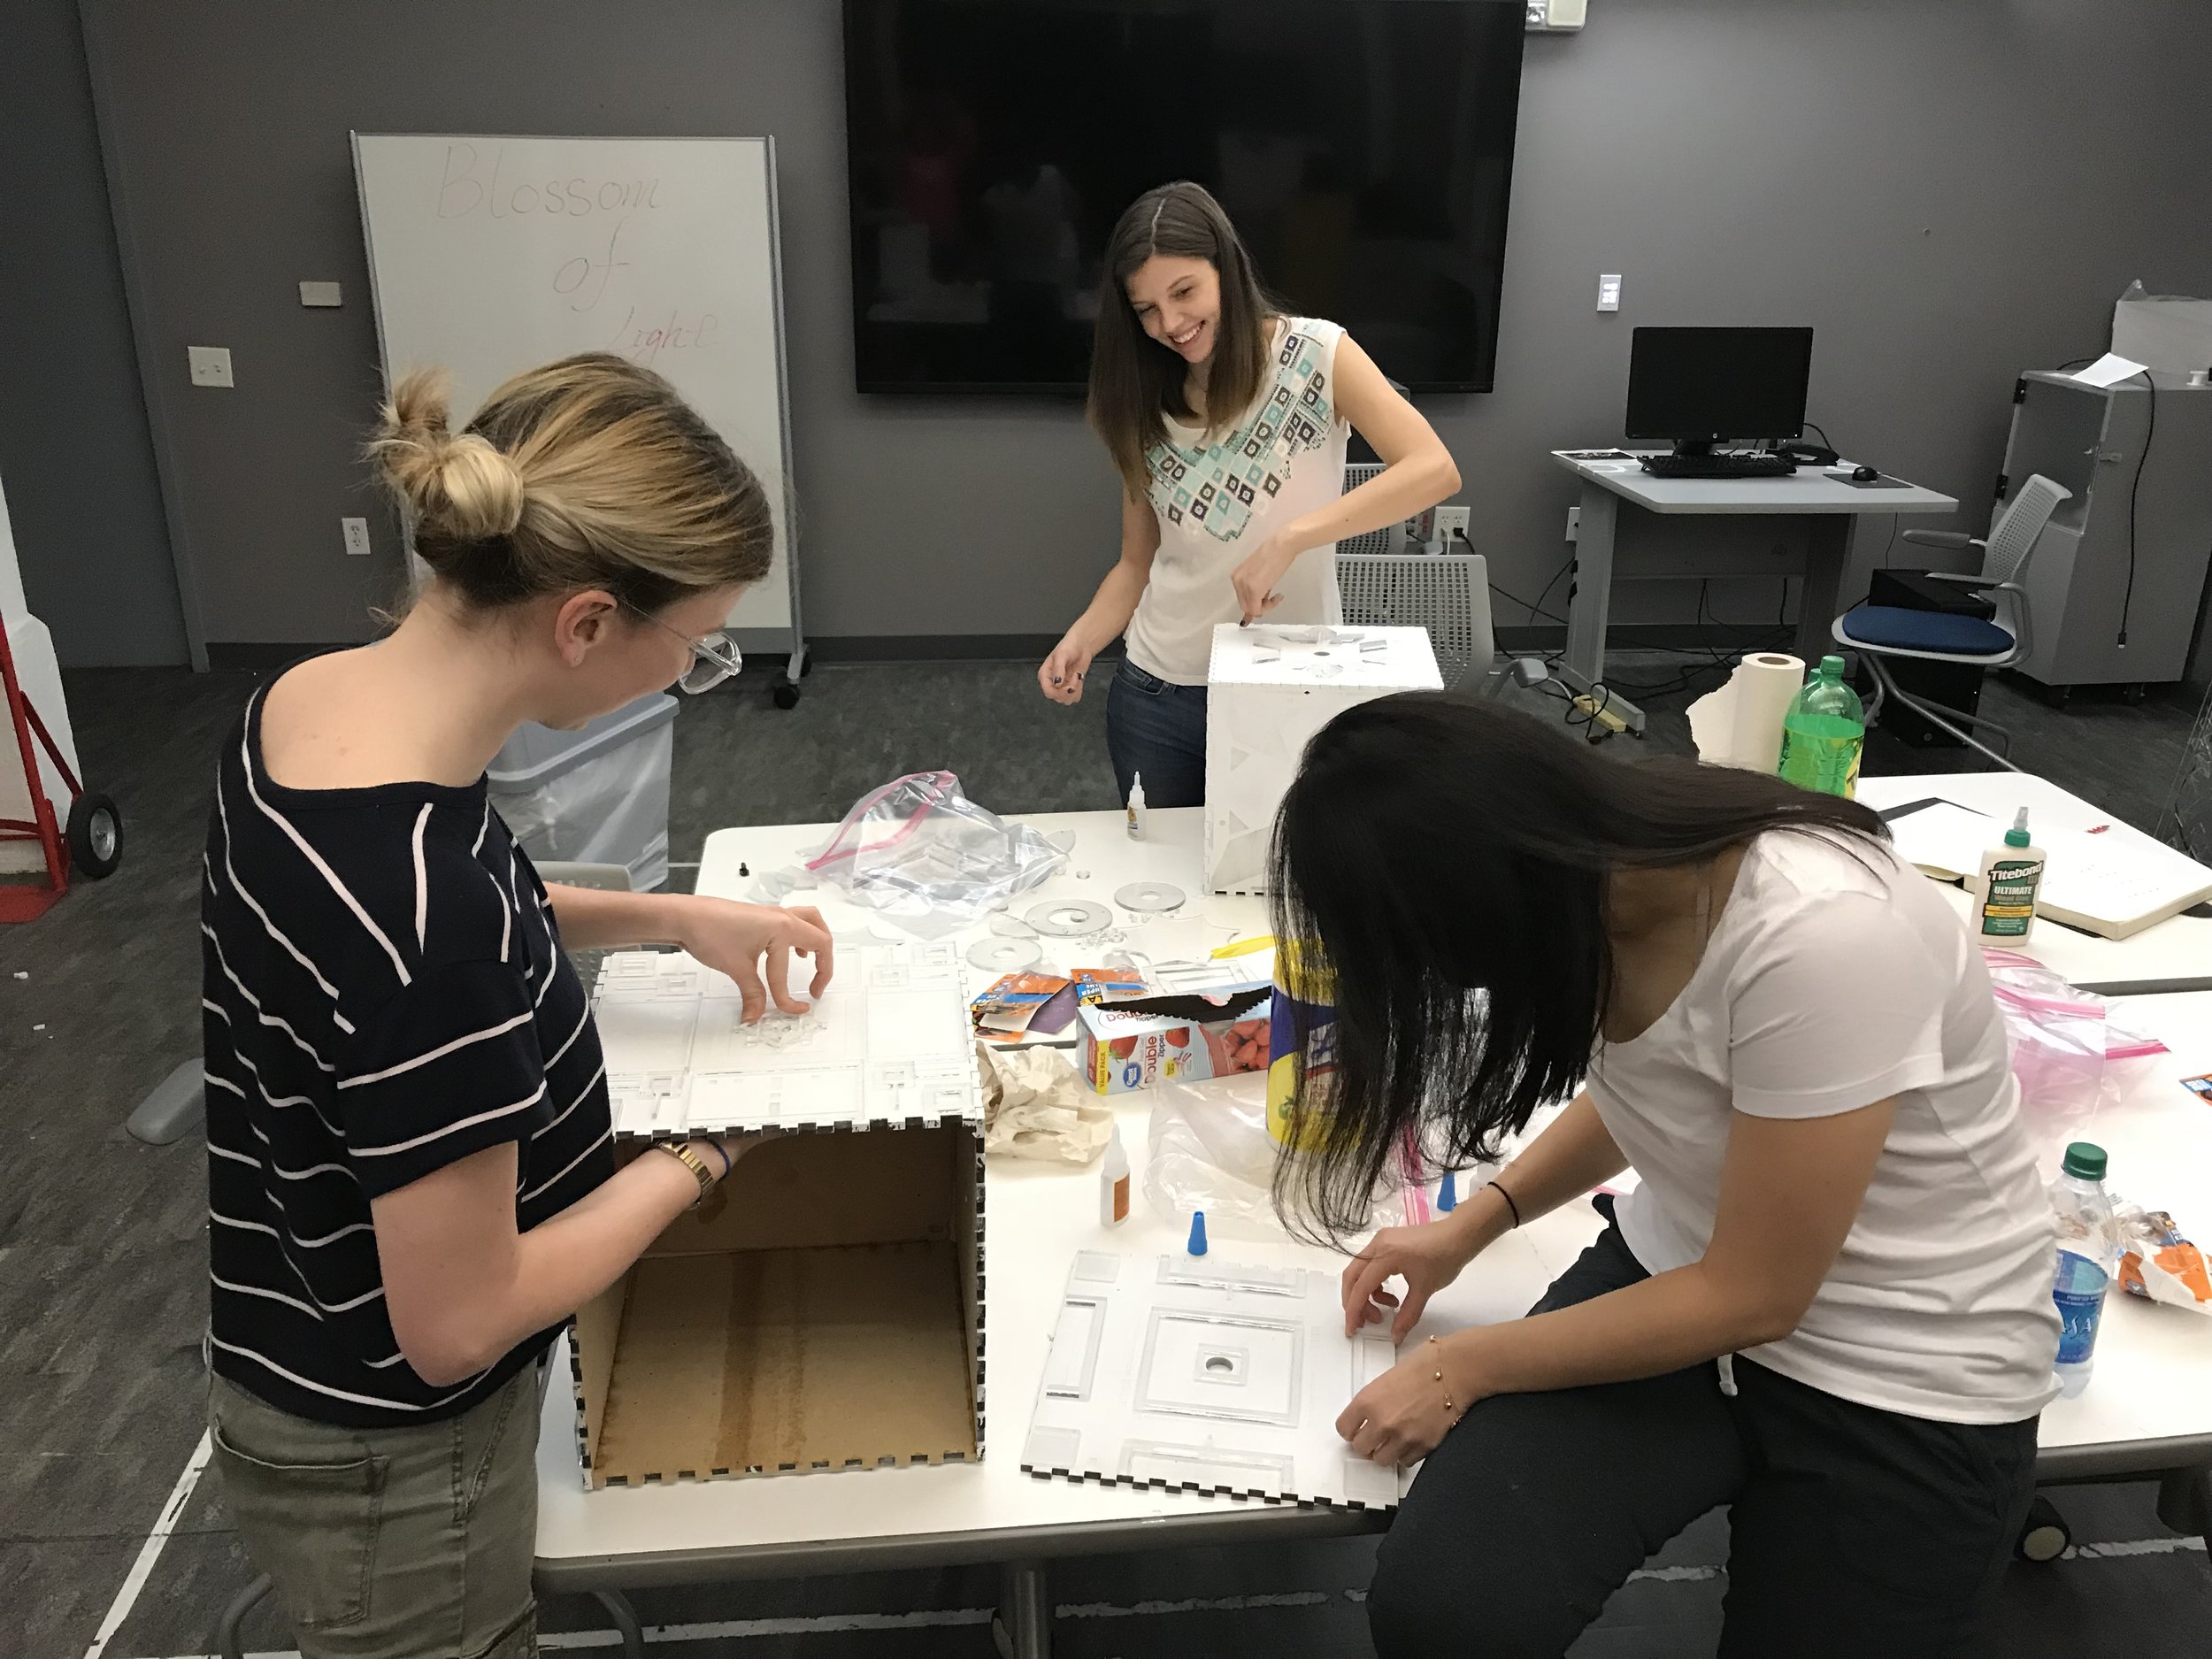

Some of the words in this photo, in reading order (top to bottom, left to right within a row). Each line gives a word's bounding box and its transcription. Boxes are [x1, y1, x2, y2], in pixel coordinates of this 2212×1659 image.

[437, 142, 661, 219] Blossom
[553, 216, 631, 312] of
[1990, 862, 2044, 881] Titebond
[1994, 886, 2032, 895] ULTIMATE
[1144, 1036, 1156, 1084] Double
[1157, 1034, 1166, 1058] Zipper
